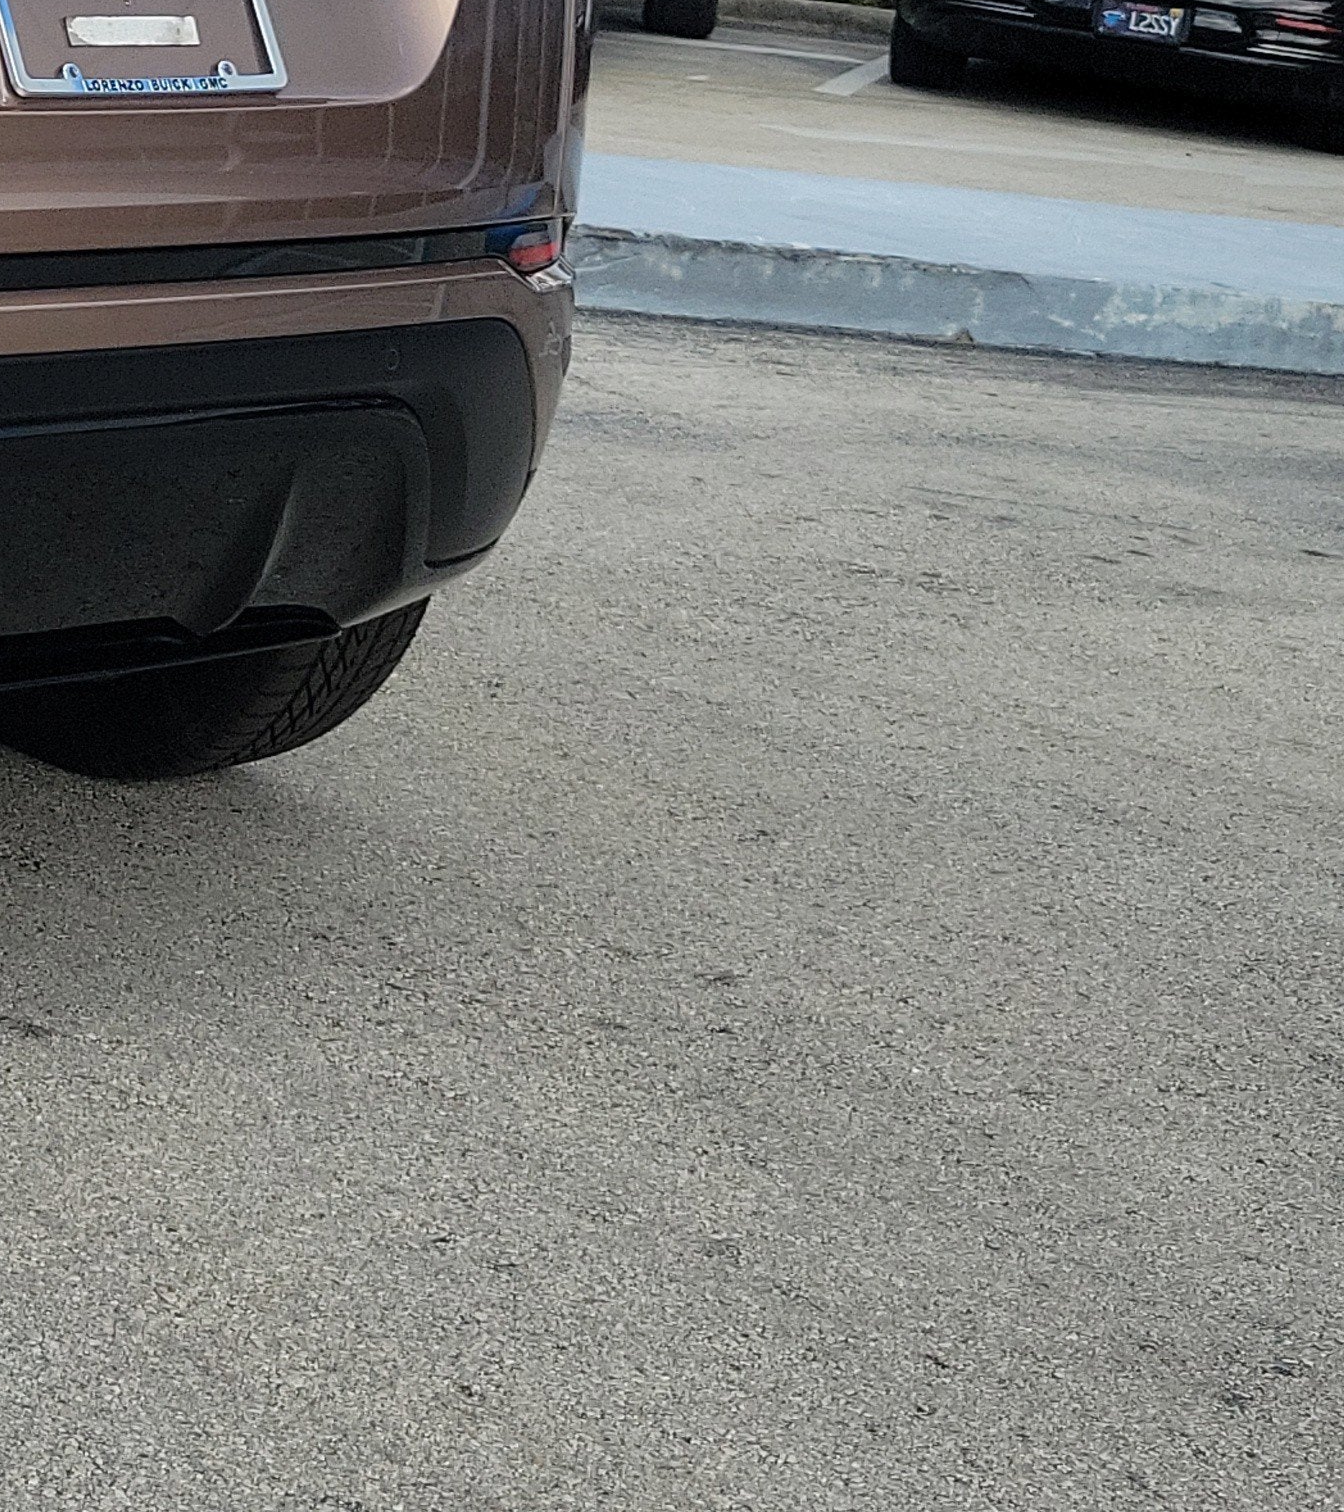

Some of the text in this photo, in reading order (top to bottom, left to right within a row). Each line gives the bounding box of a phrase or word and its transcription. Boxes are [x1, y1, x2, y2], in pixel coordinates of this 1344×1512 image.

[84, 77, 229, 92] LORENZO BUICK GMC
